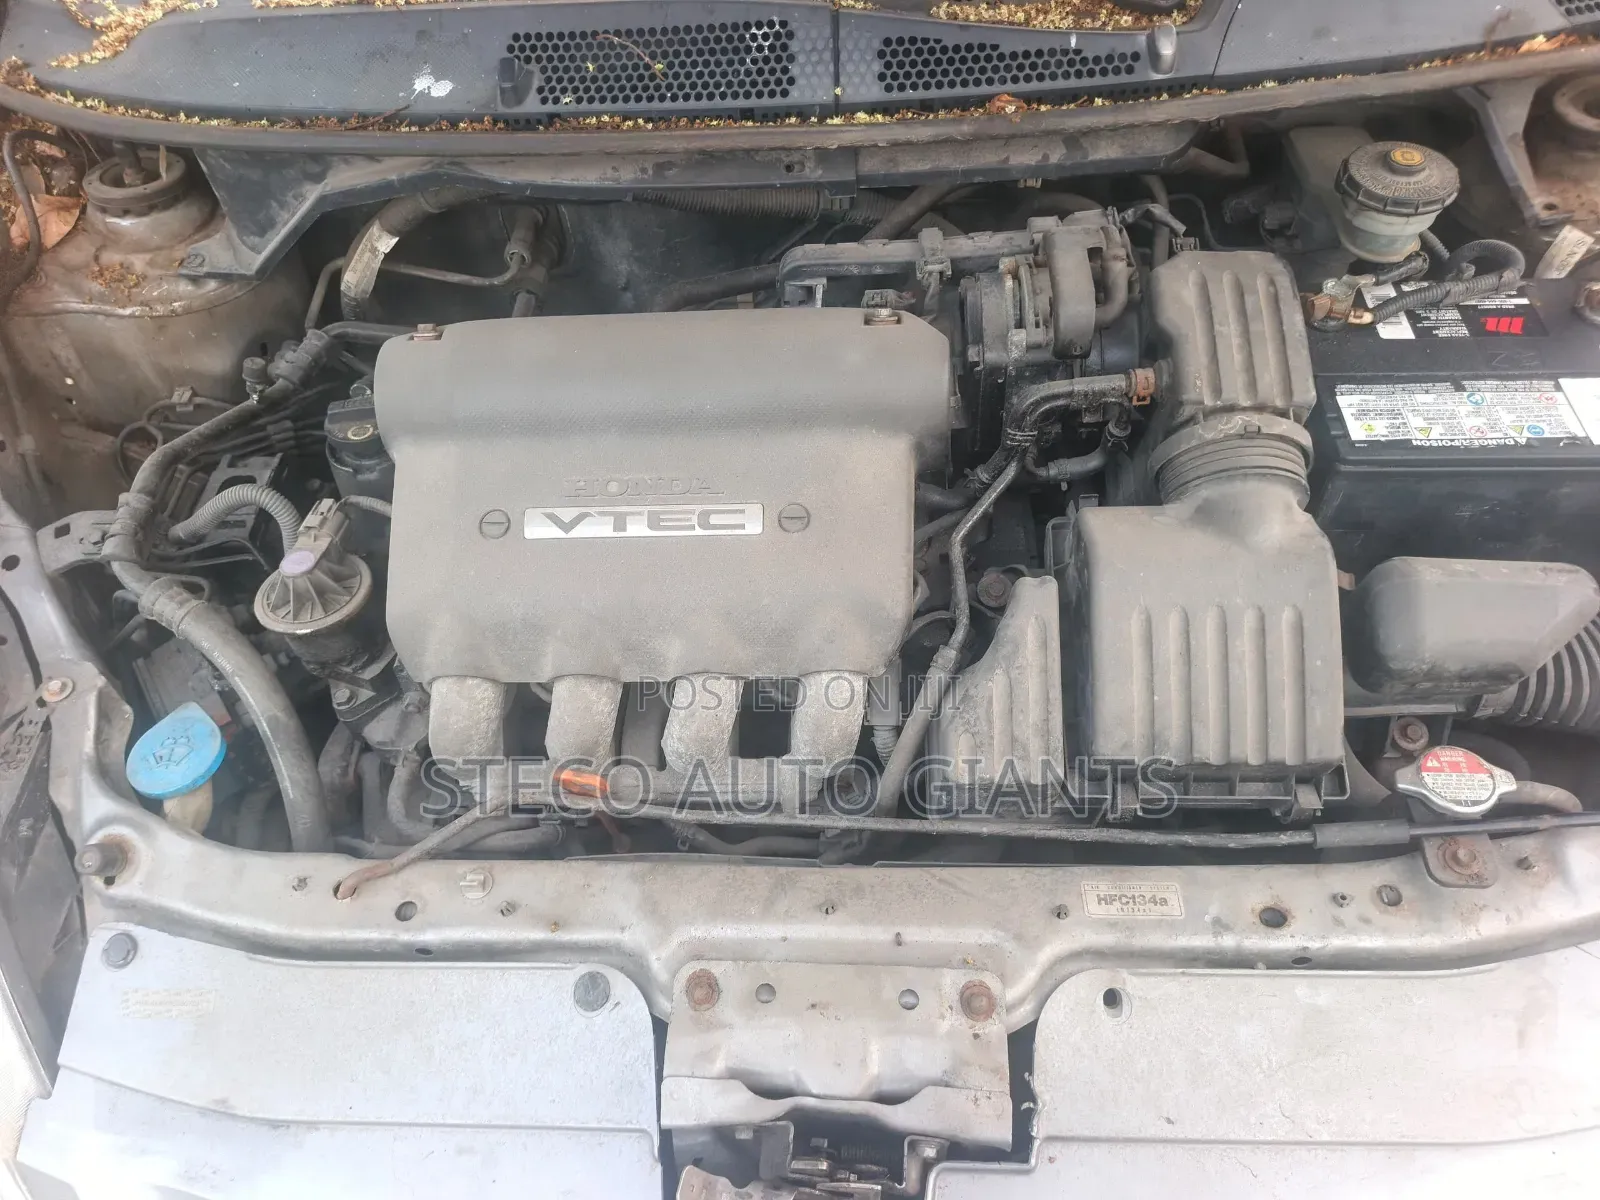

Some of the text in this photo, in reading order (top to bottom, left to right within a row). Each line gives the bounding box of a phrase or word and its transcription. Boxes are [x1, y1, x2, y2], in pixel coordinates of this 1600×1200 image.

[1411, 438, 1515, 448] DANGER/POISON
[564, 475, 724, 498] HONDA
[541, 508, 746, 535] VTEC
[1096, 893, 1169, 907] HFC134a
